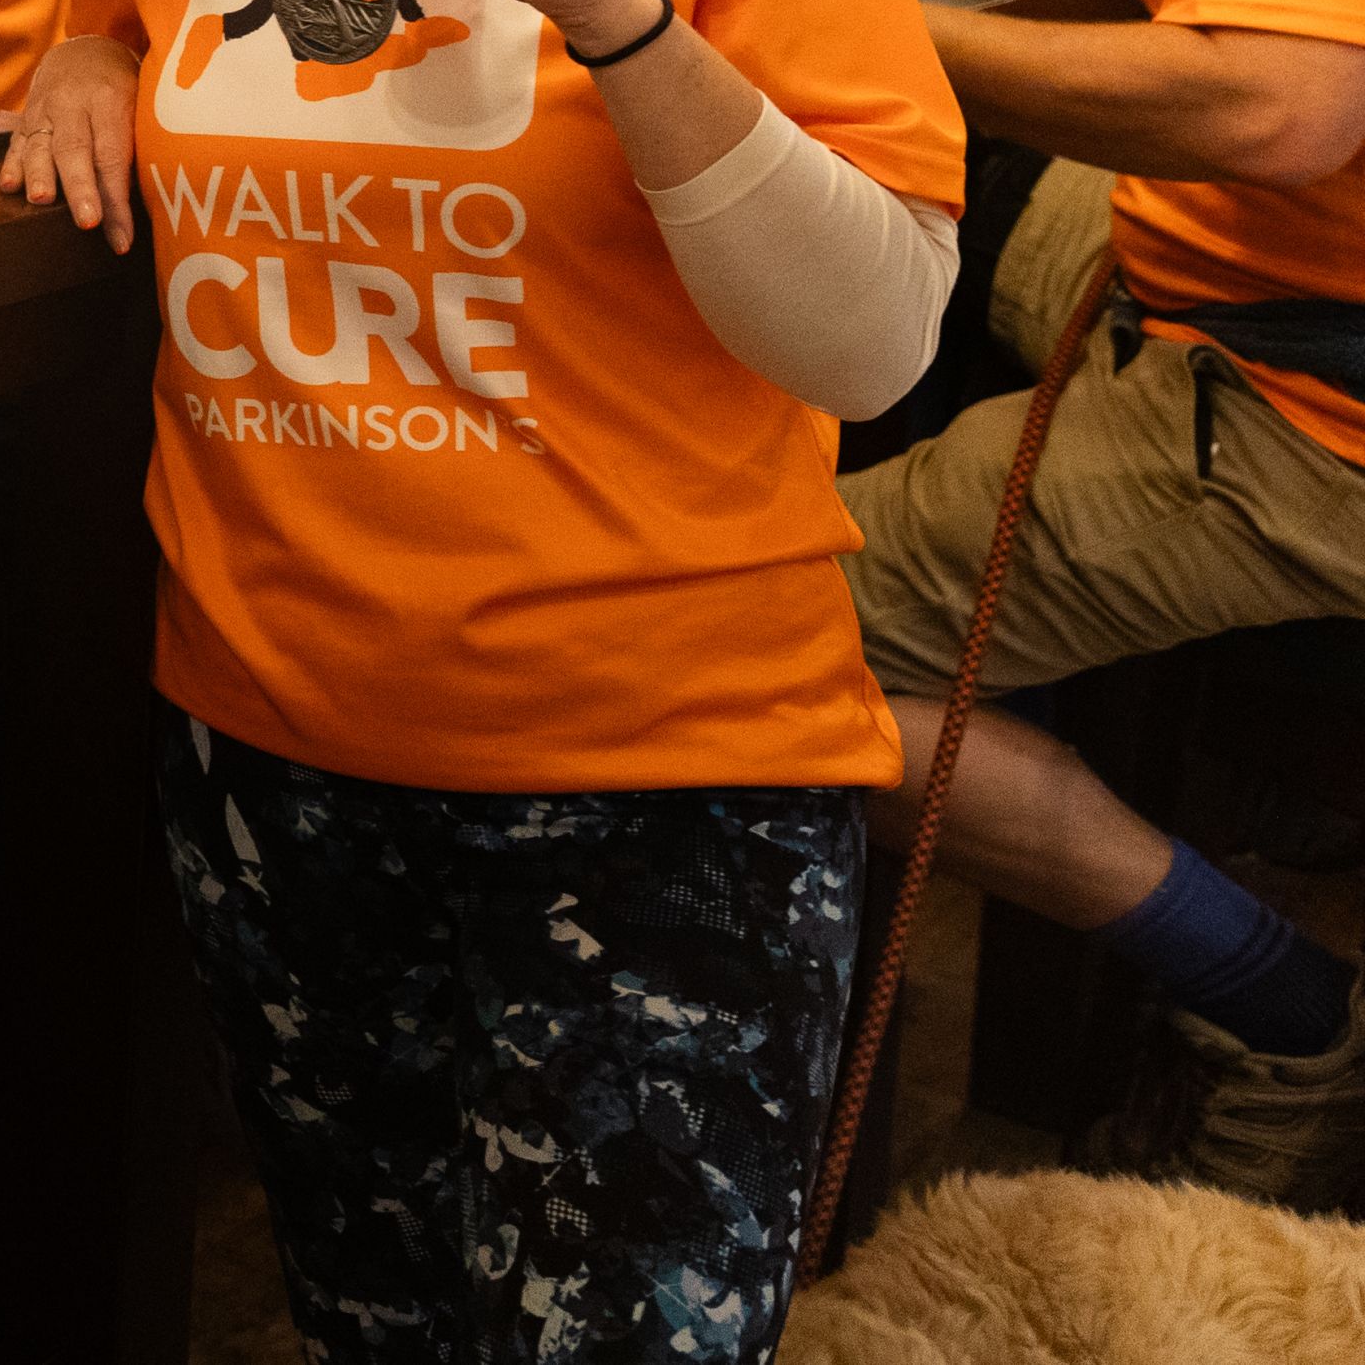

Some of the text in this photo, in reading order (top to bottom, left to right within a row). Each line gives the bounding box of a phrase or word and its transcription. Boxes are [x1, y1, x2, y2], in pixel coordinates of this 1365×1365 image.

[149, 161, 528, 260] WALK TO
[166, 251, 529, 401] CURE
[183, 391, 545, 455] PARKINSONS
